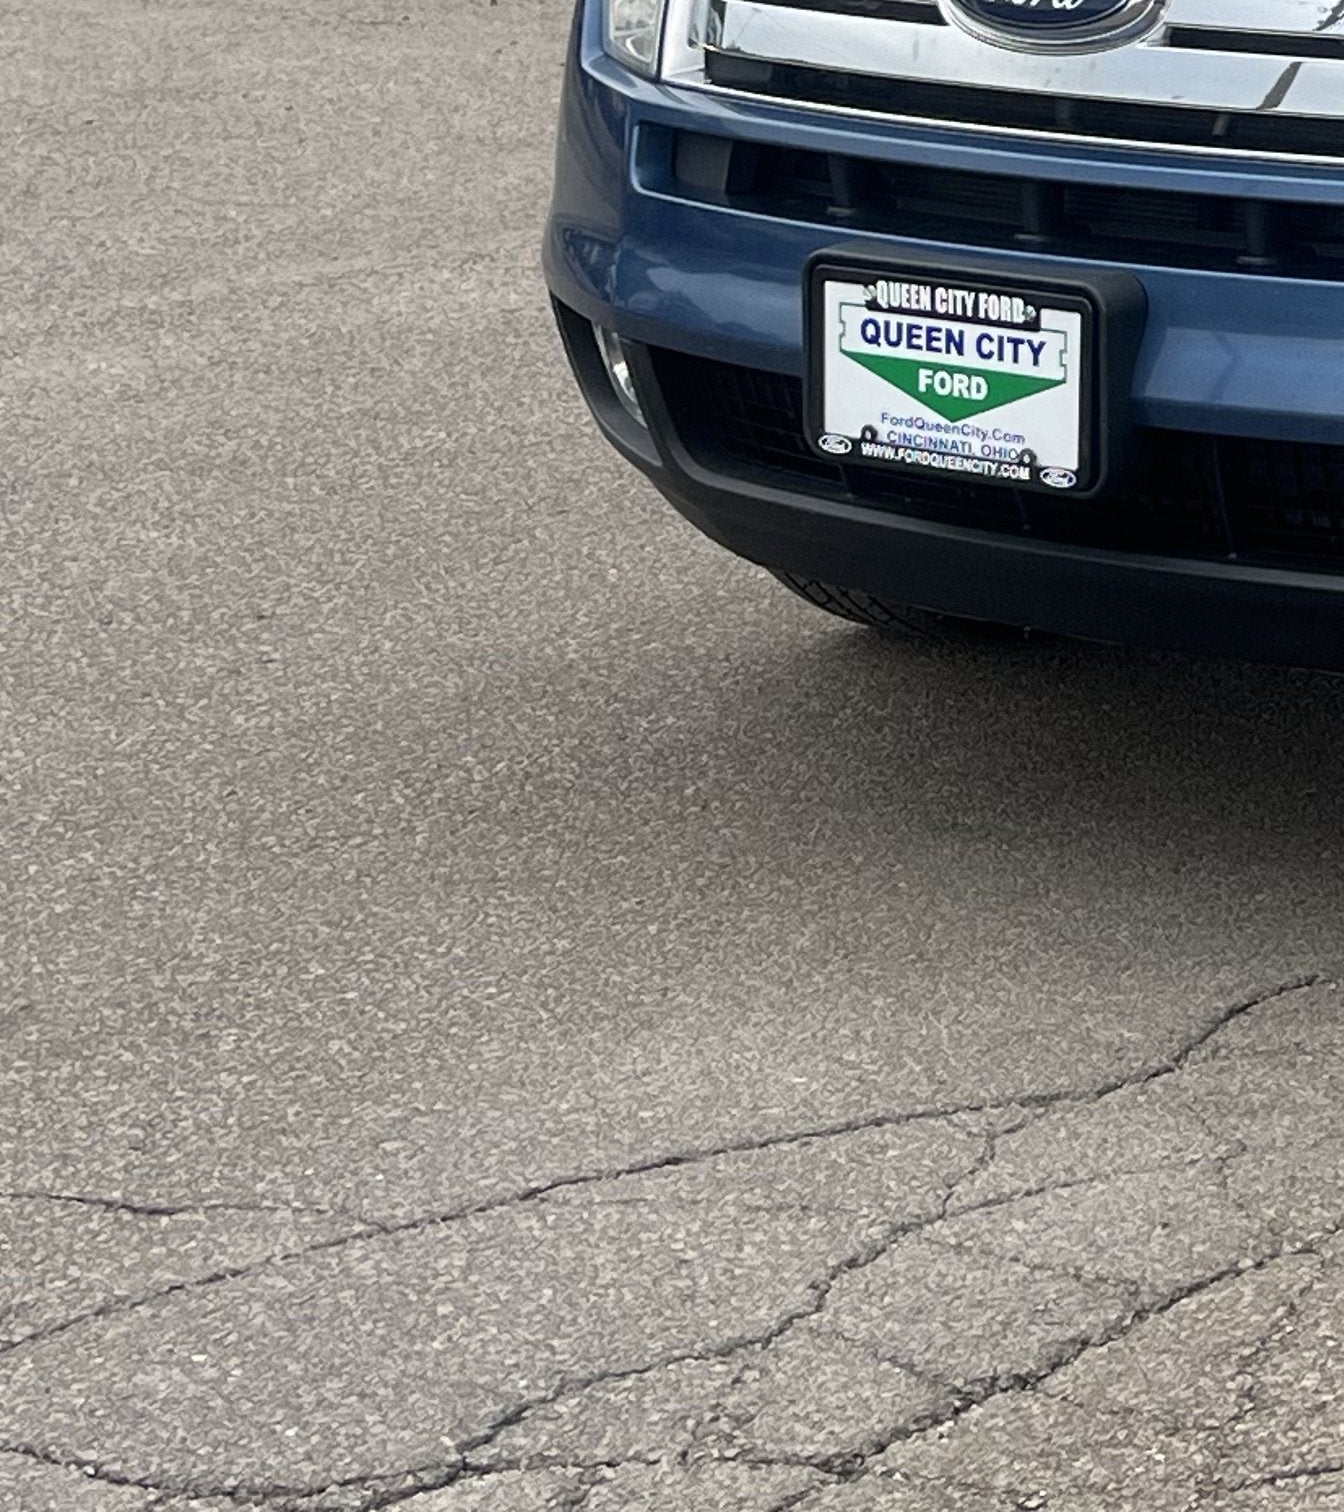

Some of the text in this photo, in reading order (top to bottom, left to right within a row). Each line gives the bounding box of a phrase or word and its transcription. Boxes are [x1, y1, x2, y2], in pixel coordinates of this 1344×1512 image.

[876, 280, 1024, 323] QUEEN CITY FORD
[860, 317, 1047, 367] QUEEN CITY
[917, 368, 989, 401] FORD
[881, 412, 1026, 445] FordQueenCity.Com
[860, 441, 1031, 480] WWW.FORDQUEENCITY.COM
[980, 444, 1019, 461] OHIO
